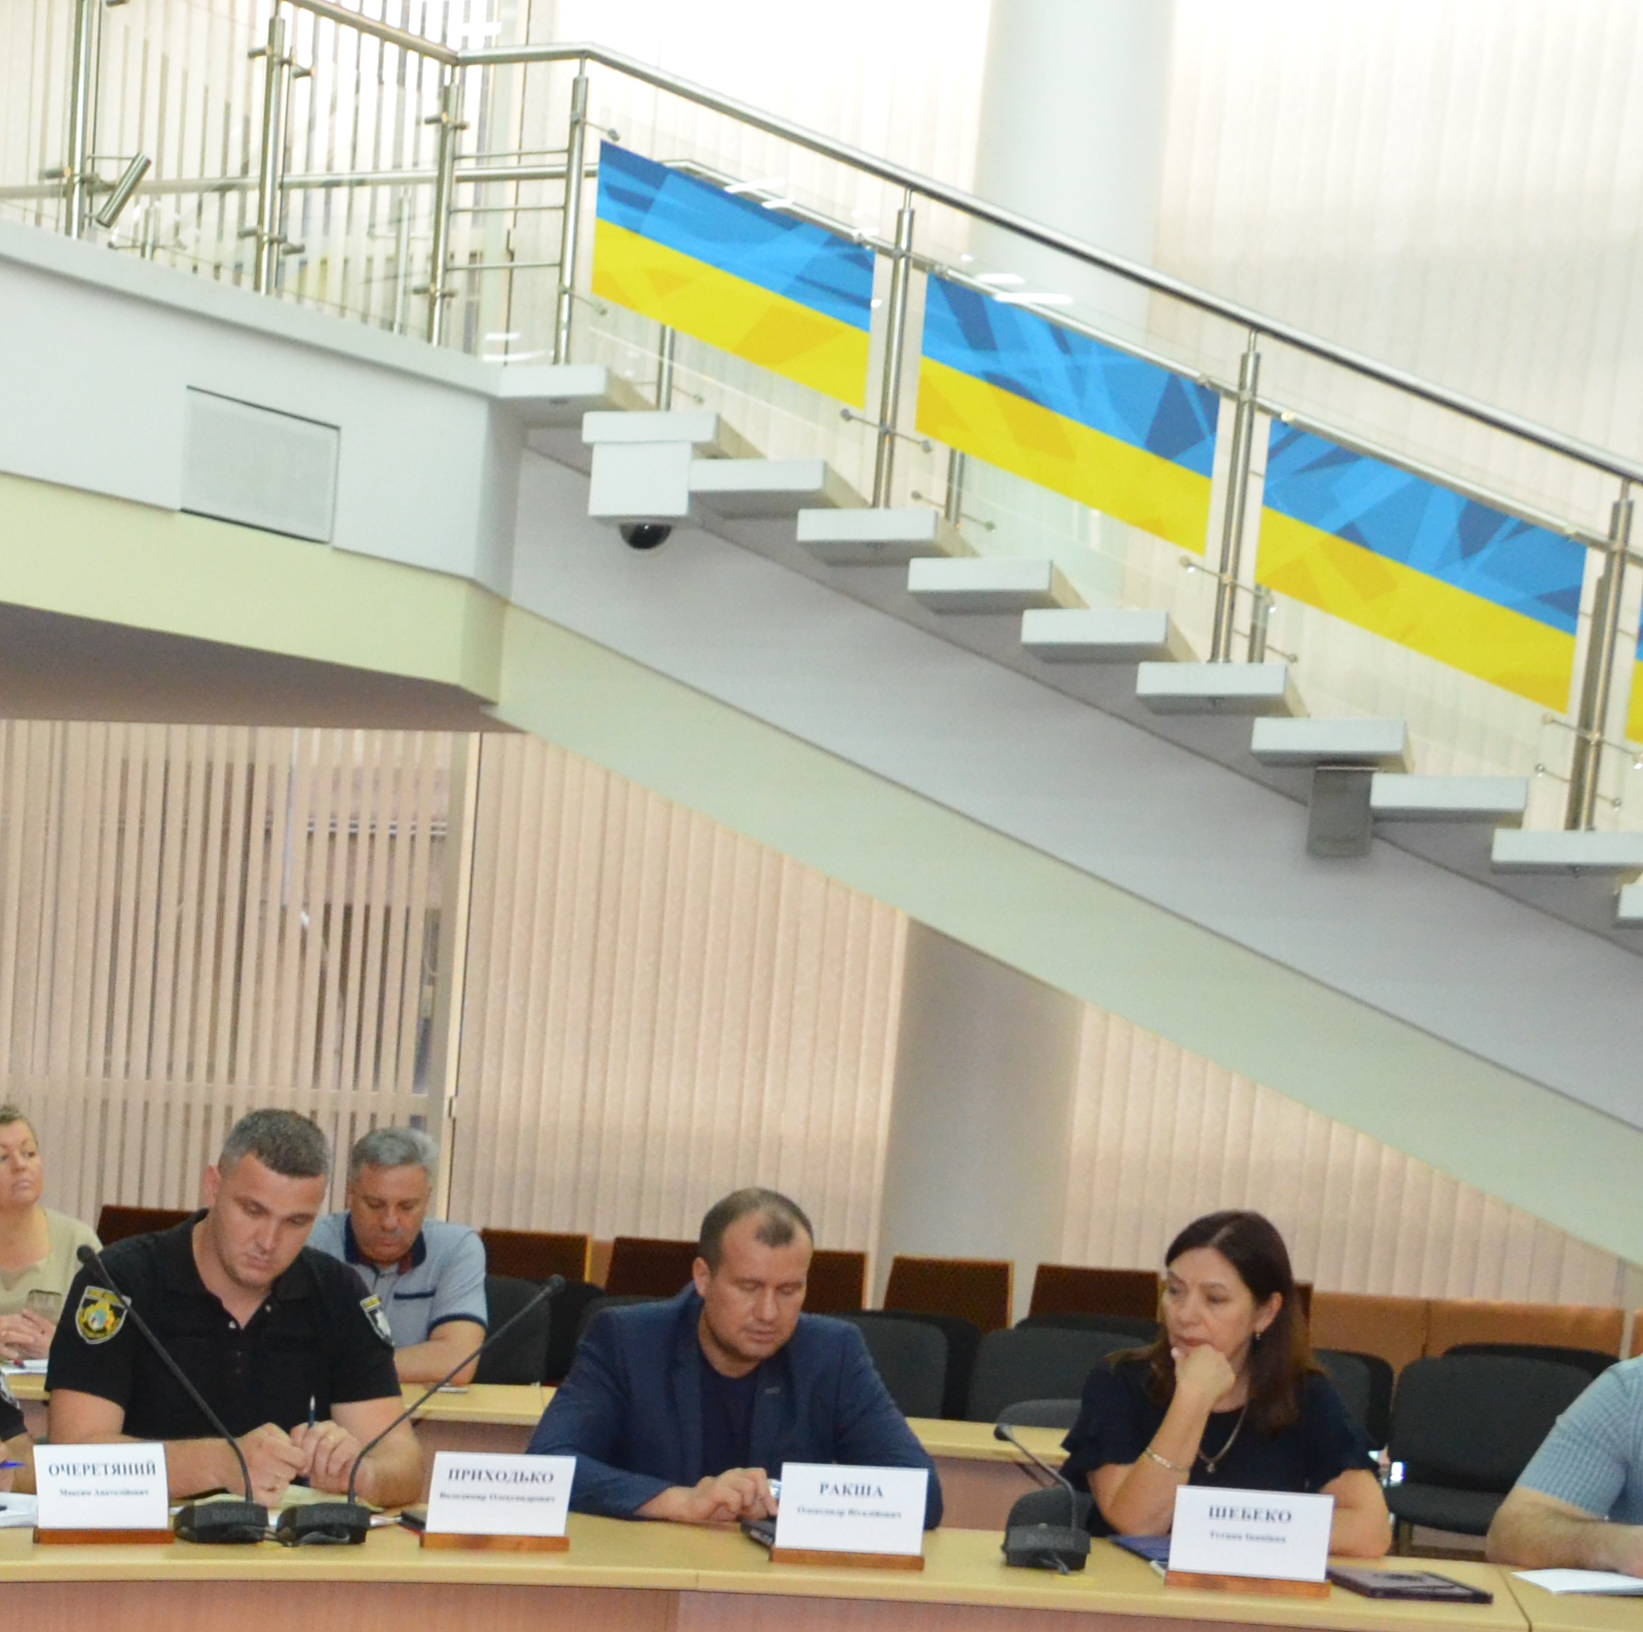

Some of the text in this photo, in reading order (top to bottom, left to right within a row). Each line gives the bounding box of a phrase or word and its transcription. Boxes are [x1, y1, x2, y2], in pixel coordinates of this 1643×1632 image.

[48, 1460, 156, 1476] ОЧЕРЕТЯНИЙ
[448, 1468, 554, 1485] ПРИХОДЬКО
[819, 1482, 883, 1498] РАКША
[1208, 1505, 1292, 1524] ШЕБЕКО
